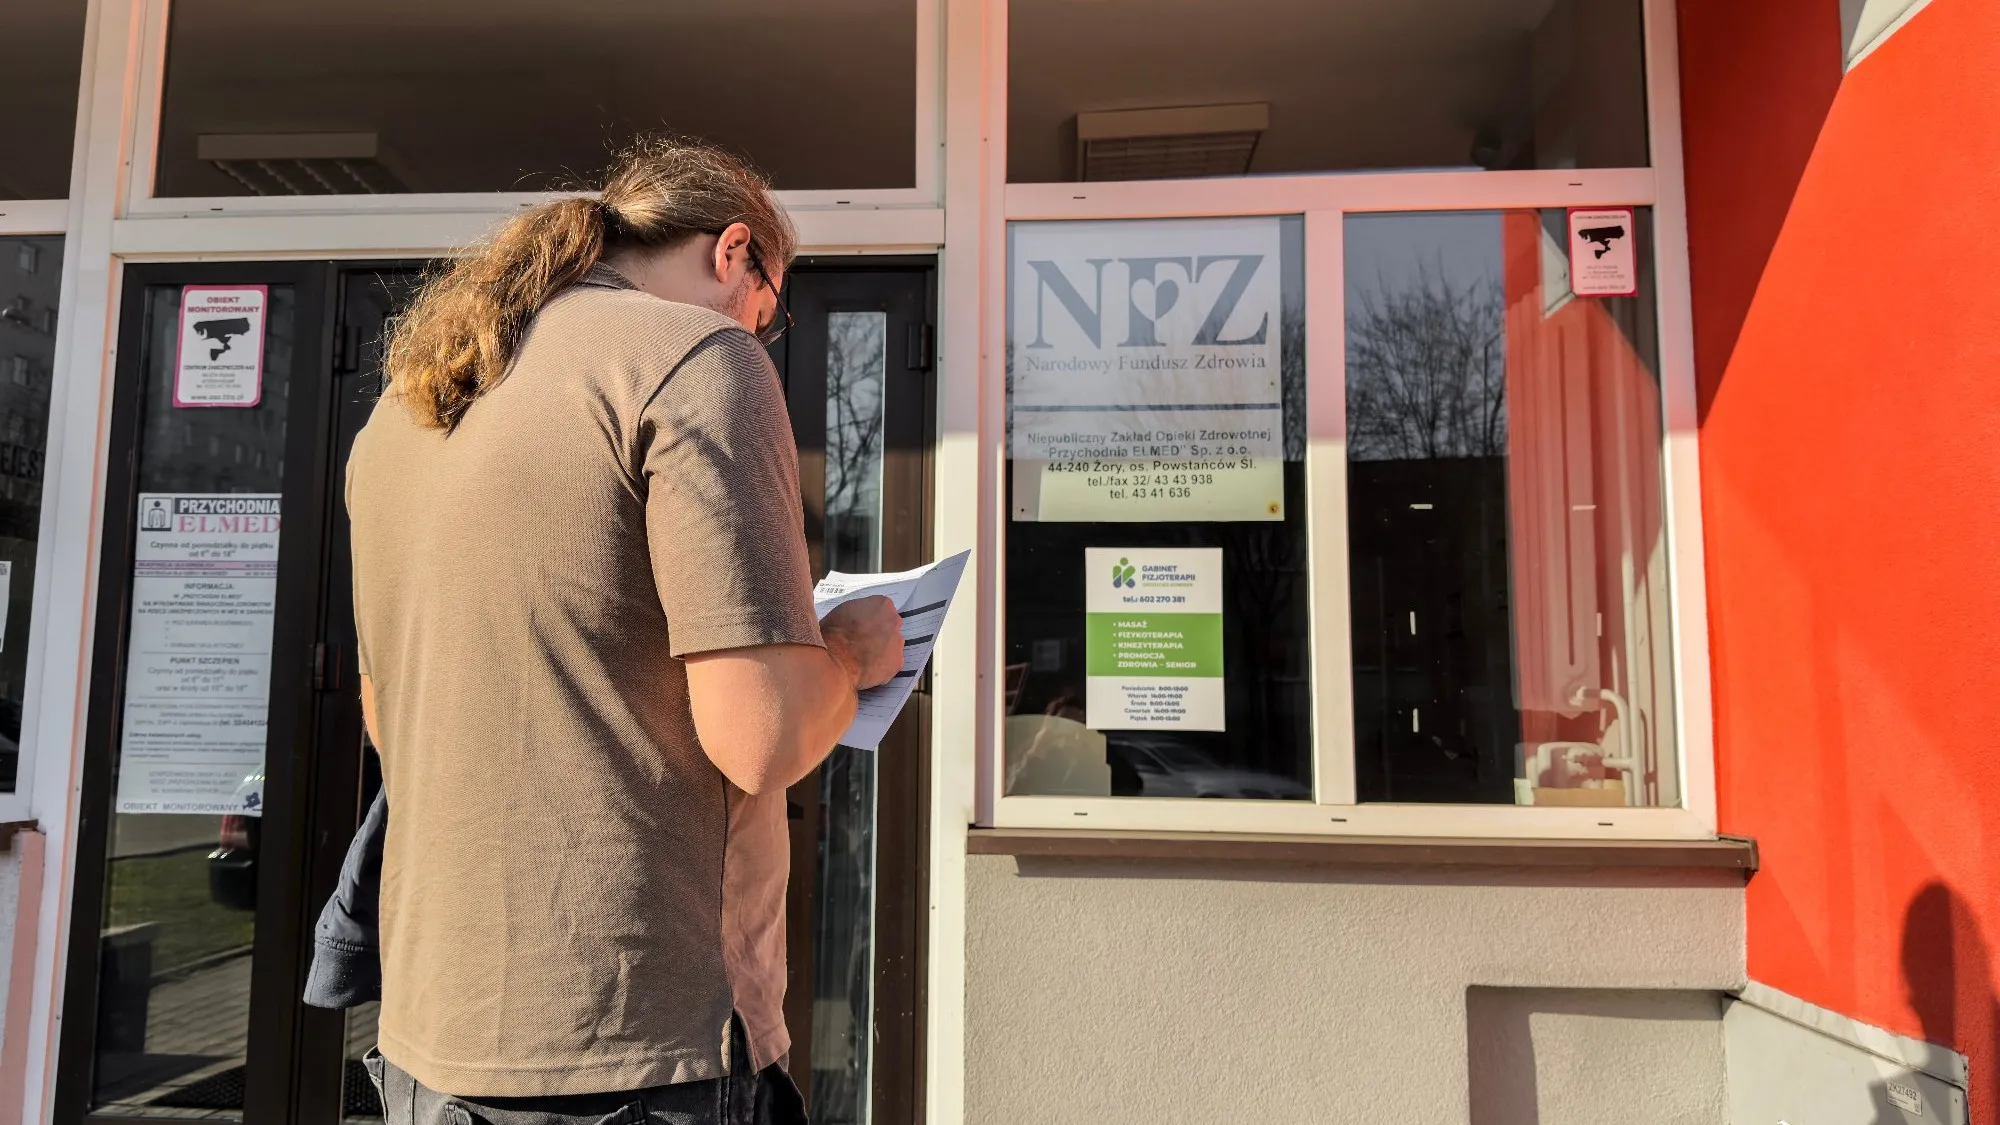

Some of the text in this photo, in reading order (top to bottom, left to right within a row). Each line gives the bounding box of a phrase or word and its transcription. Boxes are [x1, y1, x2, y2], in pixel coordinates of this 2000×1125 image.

[1026, 254, 1269, 350] NFZ
[187, 306, 260, 314] MONITOROWANY
[1026, 354, 1266, 375] Narodowy Fundusz Zdrowia
[1028, 428, 1271, 445] Niepubliczny Zakład Opieki Zdrowotnej
[1191, 444, 1213, 459] Sp.
[1215, 447, 1223, 455] z
[1227, 445, 1250, 455] o.o.
[1048, 457, 1257, 475] 44-240 Żory, os. Powstańców Śl.
[1087, 474, 1213, 487] tel./fax 32/ 43 43 938
[1109, 488, 1191, 499] tel. 43 41 636
[179, 500, 280, 514] PRZYCHODNIA
[178, 516, 281, 533] ELMED
[150, 541, 274, 550] Czynna od poniedziałku do piątku
[1118, 620, 1148, 628] MASAŻ
[1118, 631, 1183, 639] FIZYKOTERAPIA
[1165, 661, 1197, 669] SENIOR
[123, 802, 239, 812] OBIEKT MONITOROWANY
